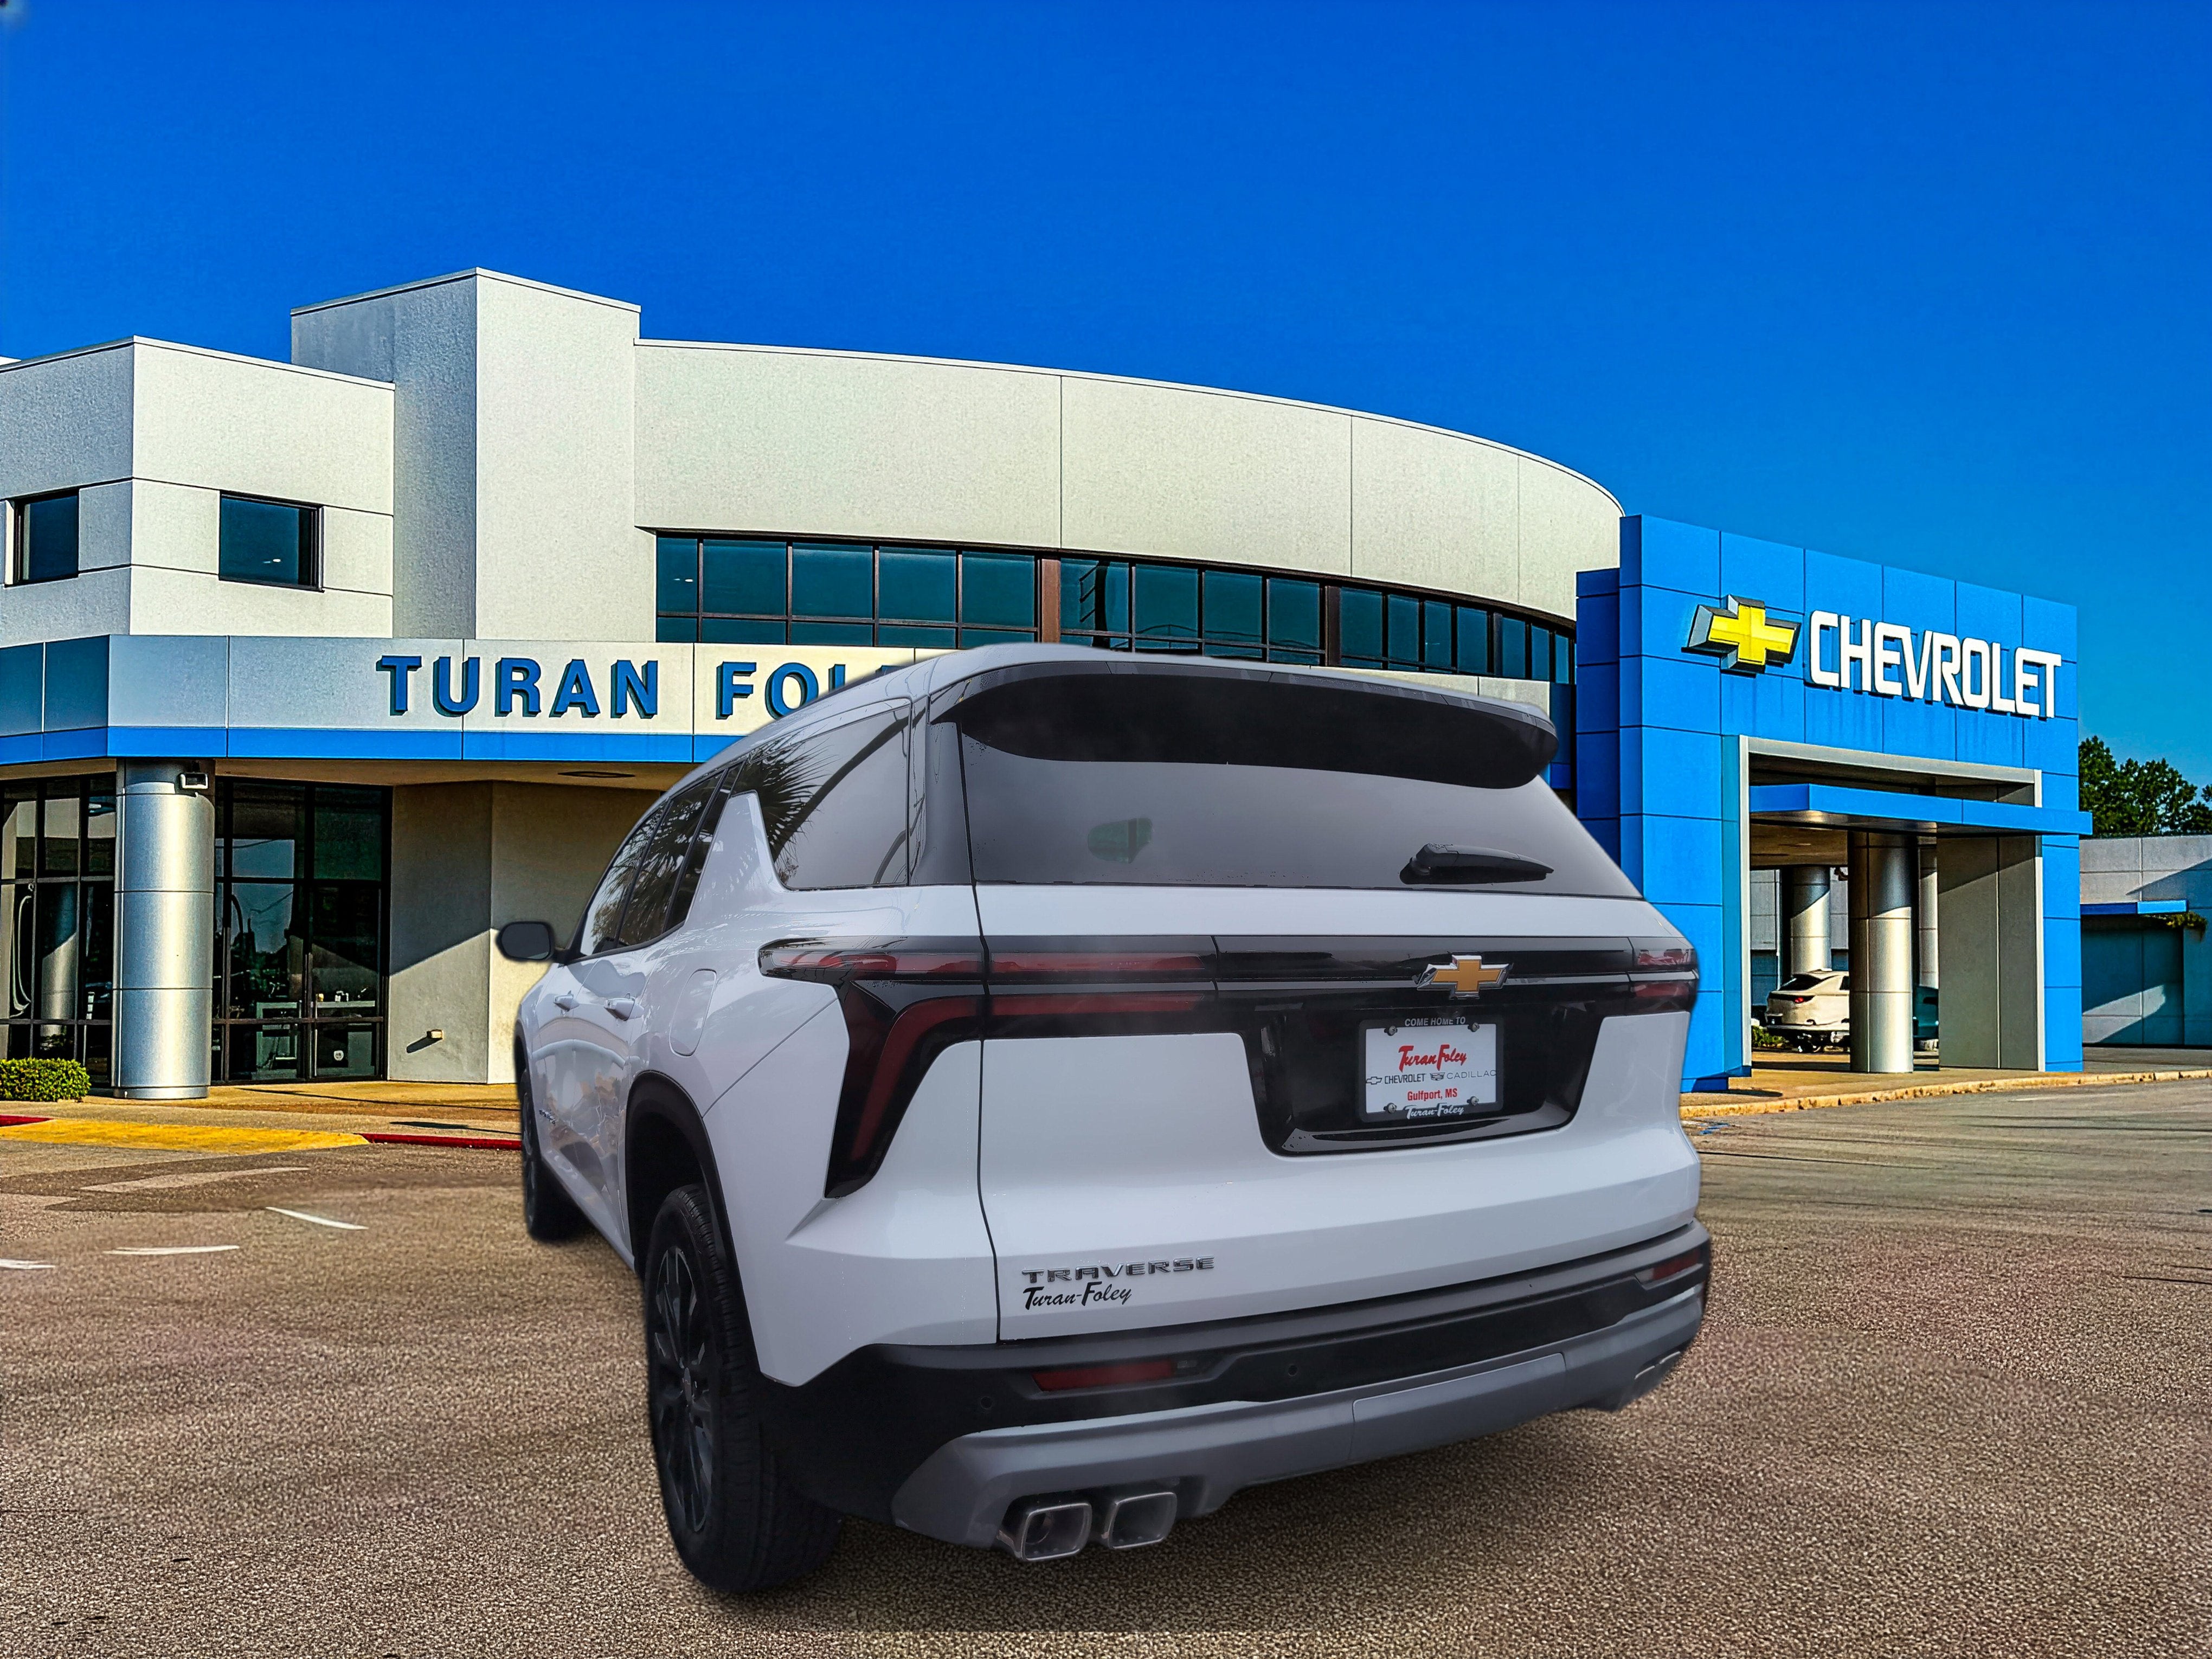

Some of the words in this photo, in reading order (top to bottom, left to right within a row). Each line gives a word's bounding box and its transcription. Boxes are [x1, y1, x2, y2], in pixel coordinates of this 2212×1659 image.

[1809, 610, 2062, 718] CHEVROLET
[376, 655, 658, 719] TURAN
[1405, 1018, 1429, 1026] COME
[1431, 1017, 1454, 1025] HOME
[1456, 1017, 1466, 1025] TO
[1384, 1073, 1426, 1084] CHEVROLET
[1446, 1070, 1497, 1079] CADILLAC
[1407, 1090, 1443, 1101] Gulfport,
[1445, 1088, 1458, 1098] MS
[1021, 1255, 1215, 1283] TRAVERSE
[1023, 1281, 1132, 1310] Turan-Foley
